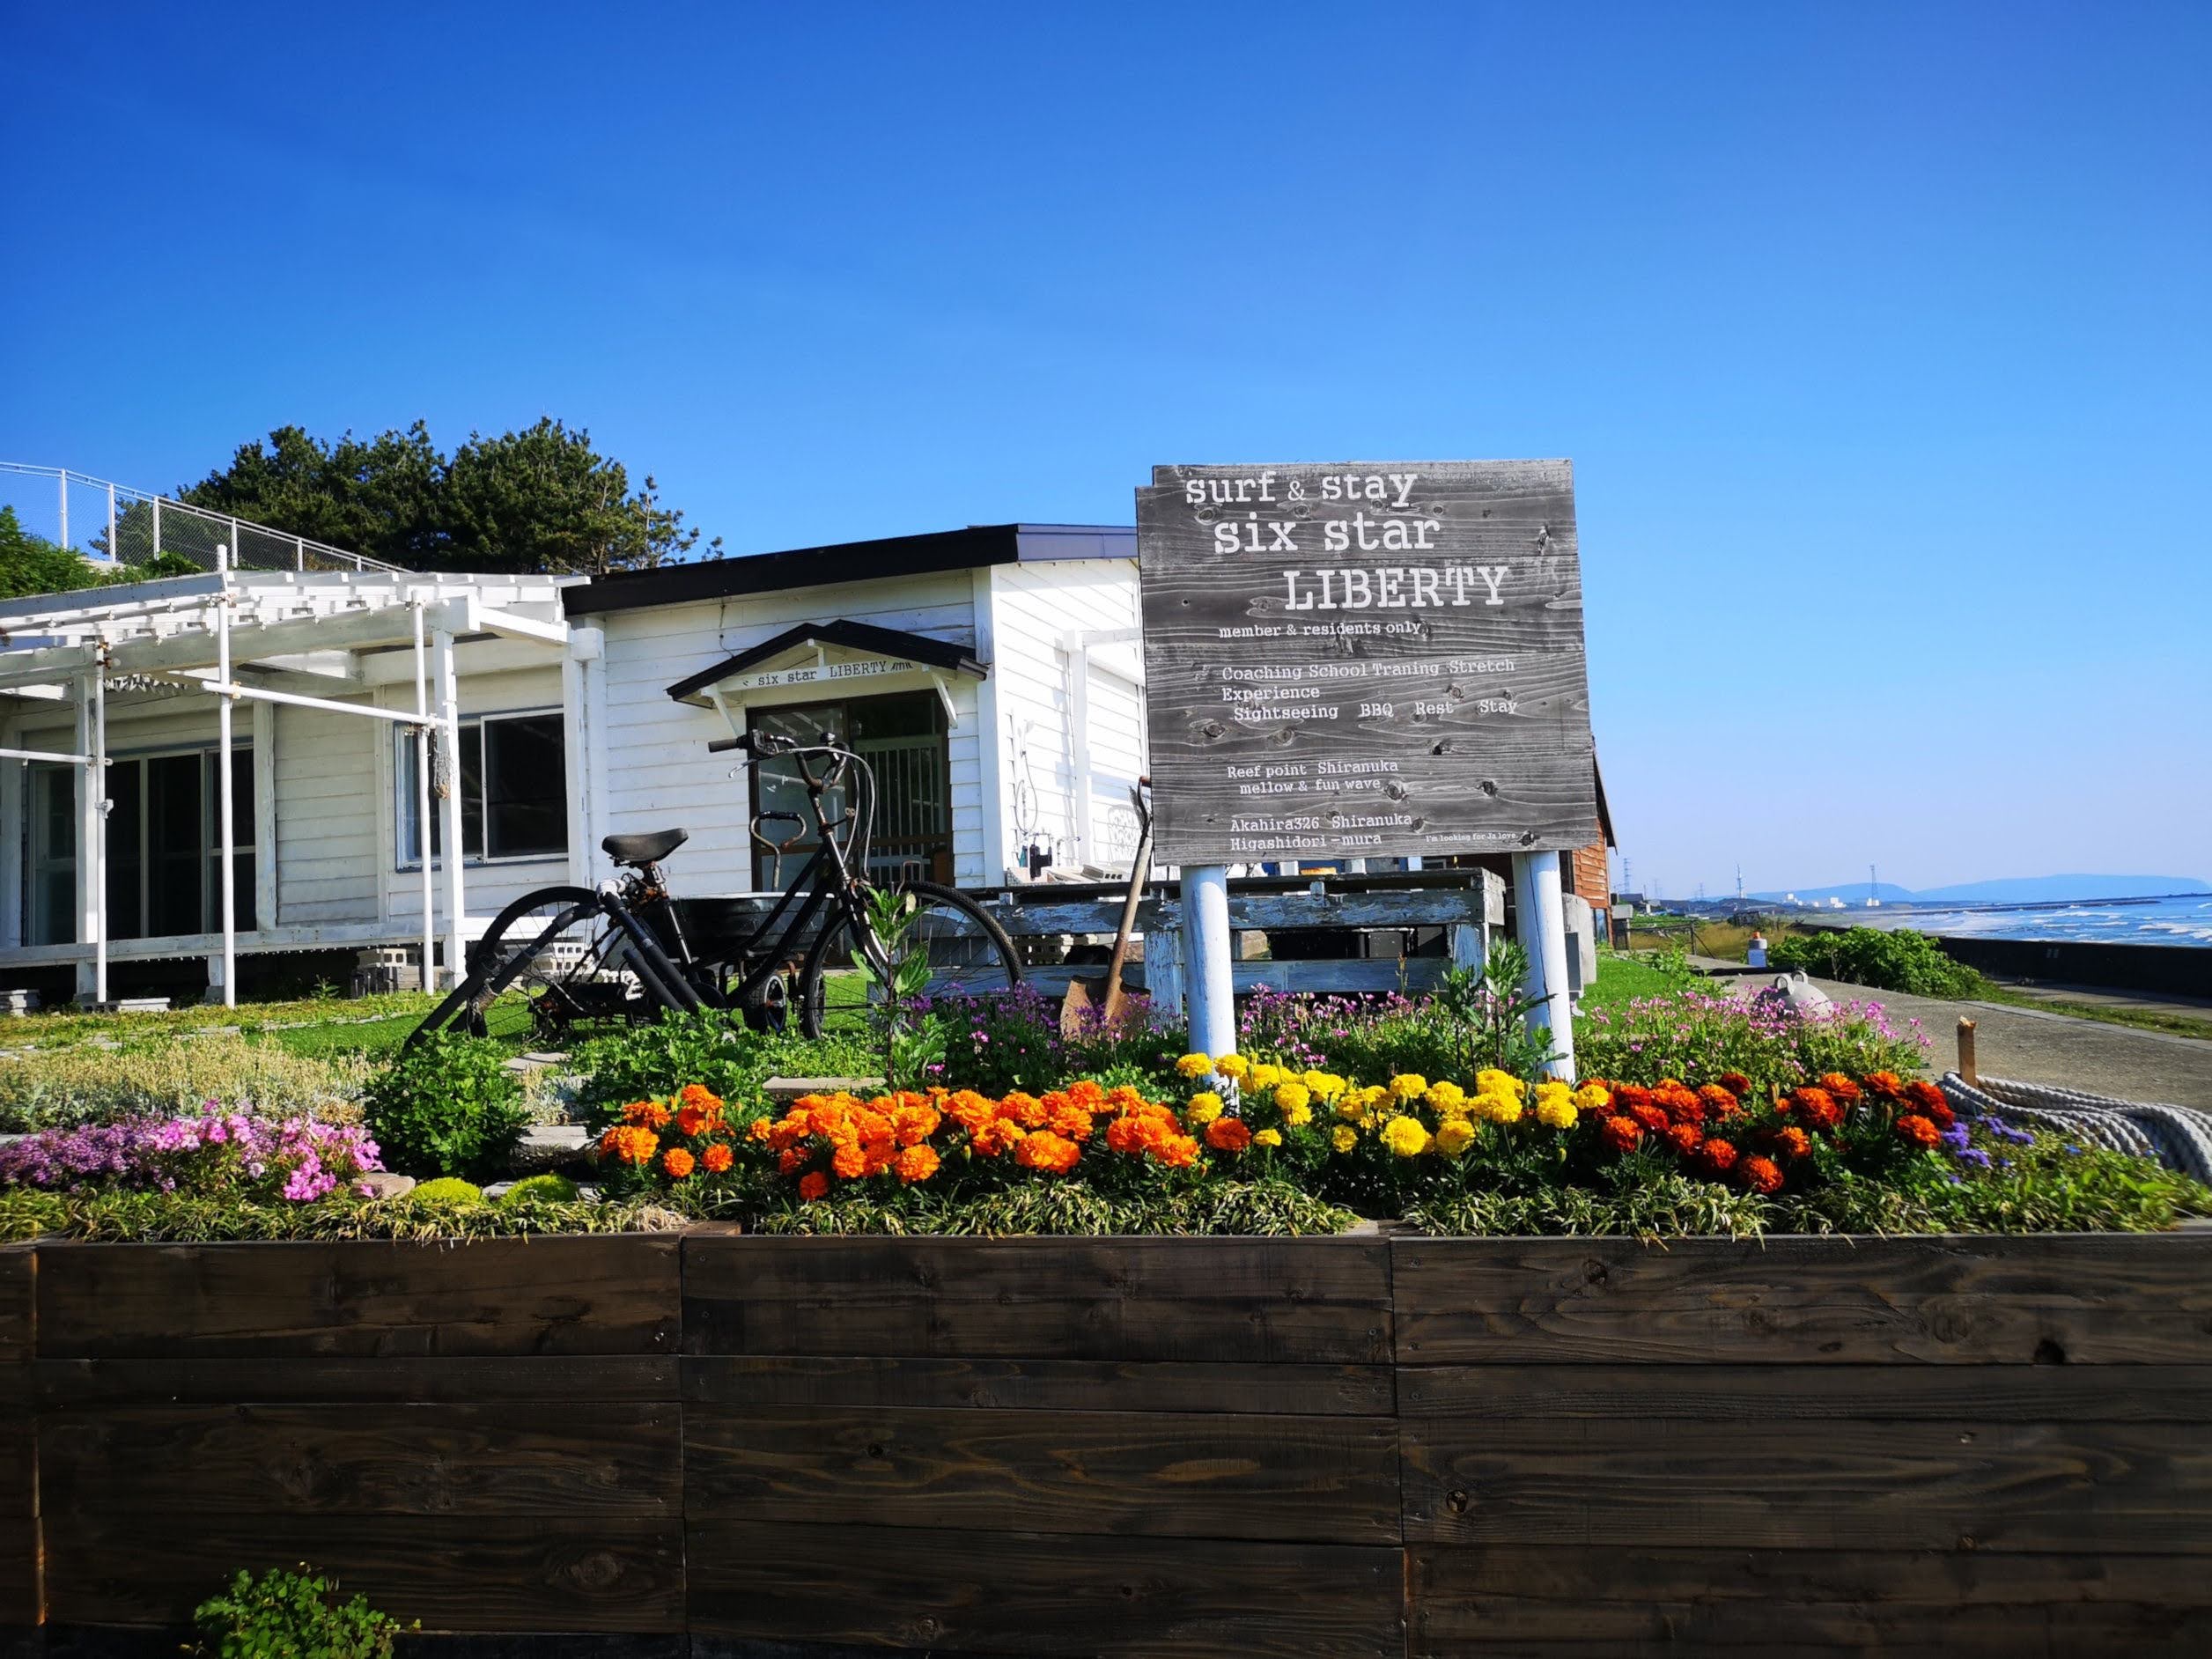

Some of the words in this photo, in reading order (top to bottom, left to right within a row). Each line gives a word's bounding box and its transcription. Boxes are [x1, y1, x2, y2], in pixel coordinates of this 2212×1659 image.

[1185, 471, 1277, 504] surf
[1287, 480, 1307, 501] &
[1321, 473, 1417, 508] stay
[1214, 512, 1299, 554] six
[1324, 512, 1441, 552] star
[1283, 566, 1509, 610] LIBERTY
[1219, 625, 1281, 638] member
[1287, 624, 1297, 636] &
[1303, 623, 1381, 636] residents
[1386, 621, 1421, 635] only
[758, 673, 778, 686] six
[787, 669, 817, 682] star
[830, 660, 887, 678] LIBERTY
[1222, 665, 1301, 681] Coaching
[1309, 663, 1366, 678] School
[1373, 661, 1440, 677] Traning
[1449, 659, 1515, 674] Stretch
[1222, 687, 1321, 702] Experience
[1234, 706, 1338, 722] Sightseeing
[1360, 704, 1394, 718] BBQ
[1415, 702, 1454, 716] Rest
[1479, 699, 1517, 715] Stay
[1227, 765, 1261, 778] Reef
[1266, 763, 1308, 778] point
[1317, 760, 1398, 775] Shiranuka
[1239, 781, 1293, 794] mellow
[1298, 780, 1308, 792] &
[1316, 779, 1340, 792] fun
[1345, 778, 1381, 790] wave
[1230, 817, 1319, 832] Akahira326
[1331, 813, 1412, 829] Shiranuka
[1230, 835, 1326, 852] Higashidori
[1440, 834, 1471, 843] looking
